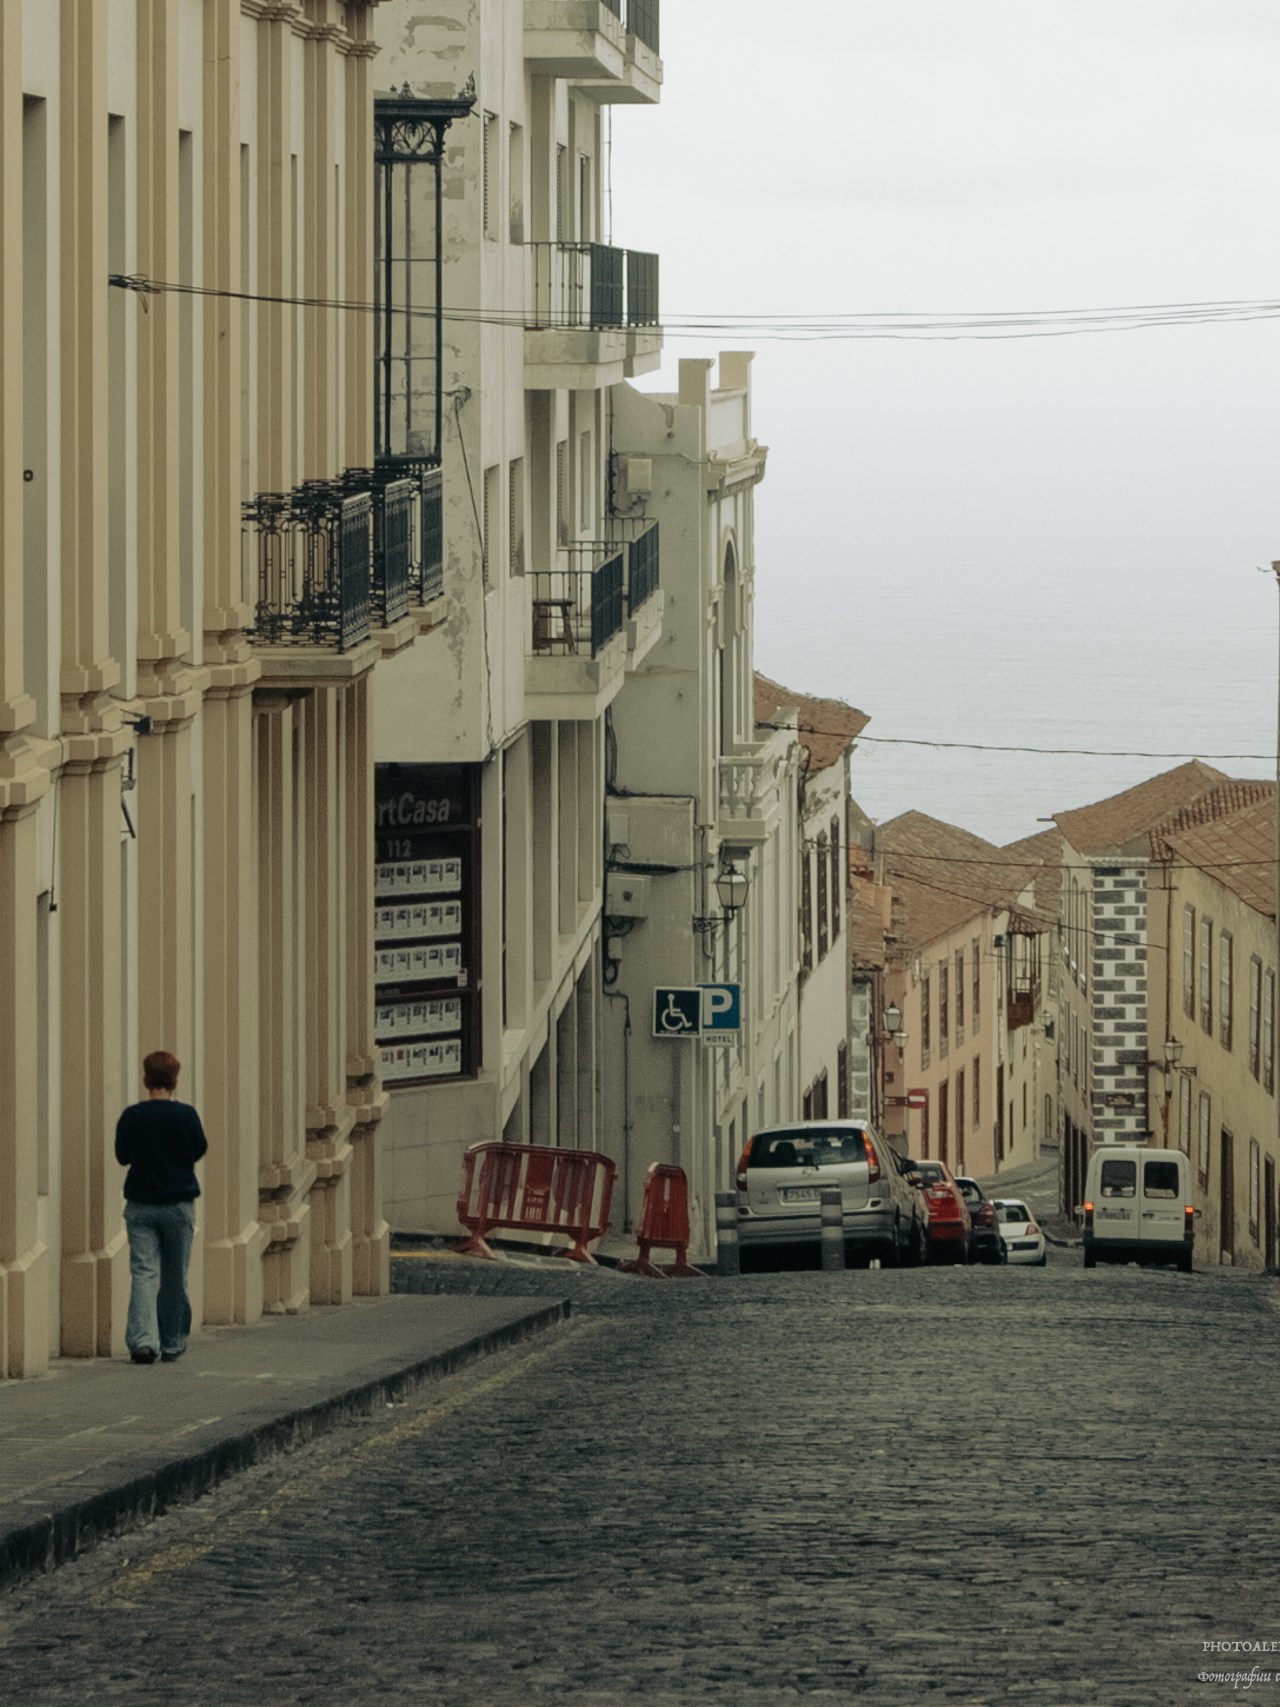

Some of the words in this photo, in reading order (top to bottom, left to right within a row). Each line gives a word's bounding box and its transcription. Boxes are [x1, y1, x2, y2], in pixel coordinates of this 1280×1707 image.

[387, 839, 412, 858] 112
[703, 988, 733, 1026] P
[706, 1035, 731, 1043] HOTEL
